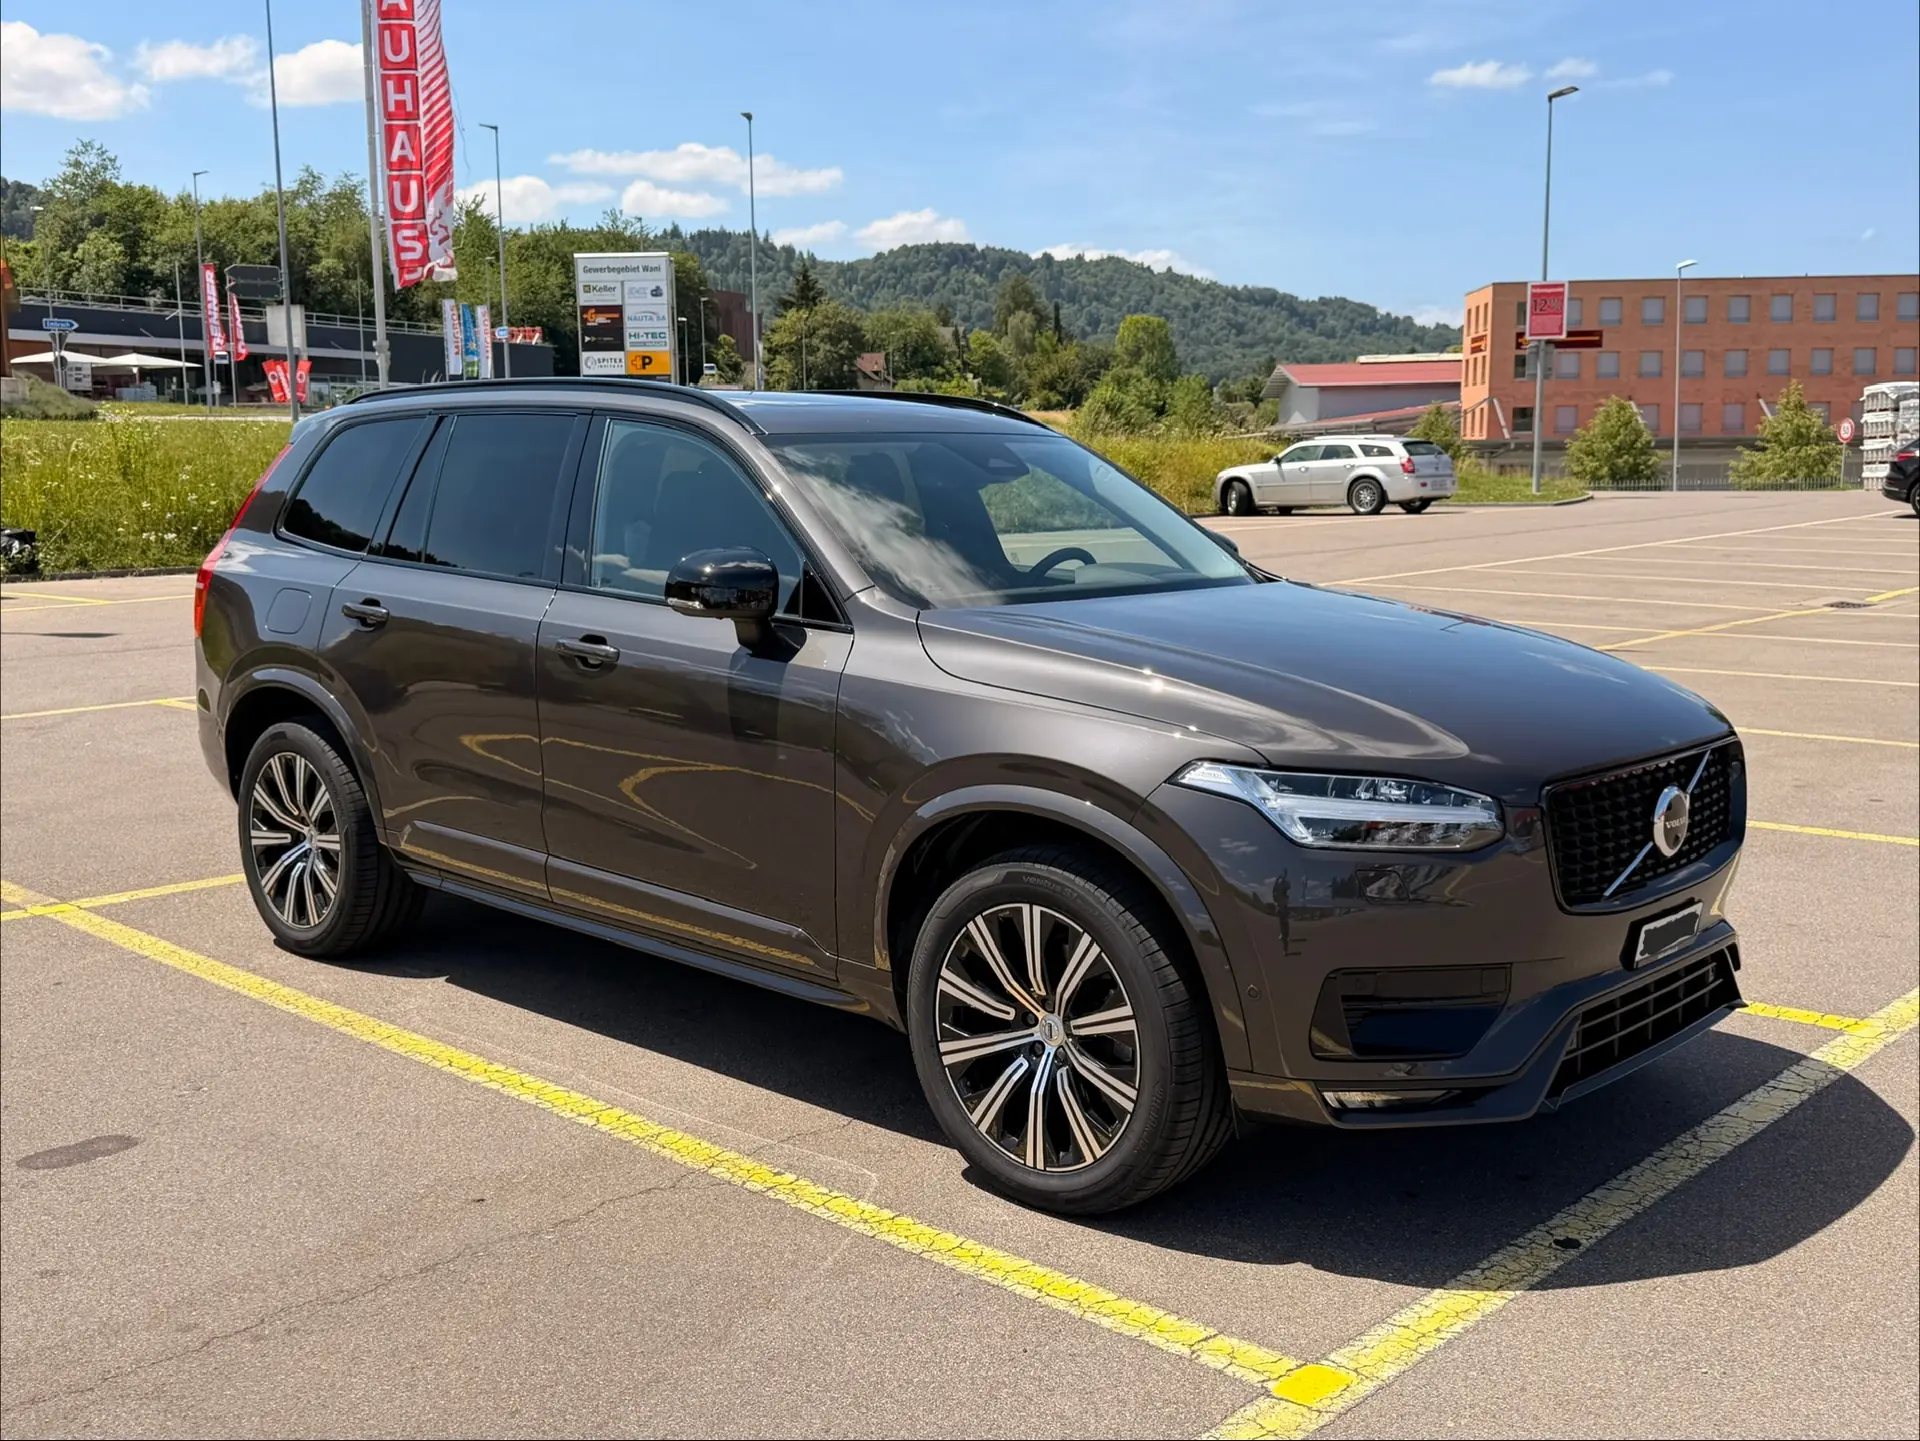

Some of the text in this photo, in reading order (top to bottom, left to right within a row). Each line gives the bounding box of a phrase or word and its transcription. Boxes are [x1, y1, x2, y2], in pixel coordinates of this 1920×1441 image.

[583, 265, 640, 275] Gewerbegebiet
[592, 284, 617, 293] Keller
[628, 331, 667, 340] HI-TEC
